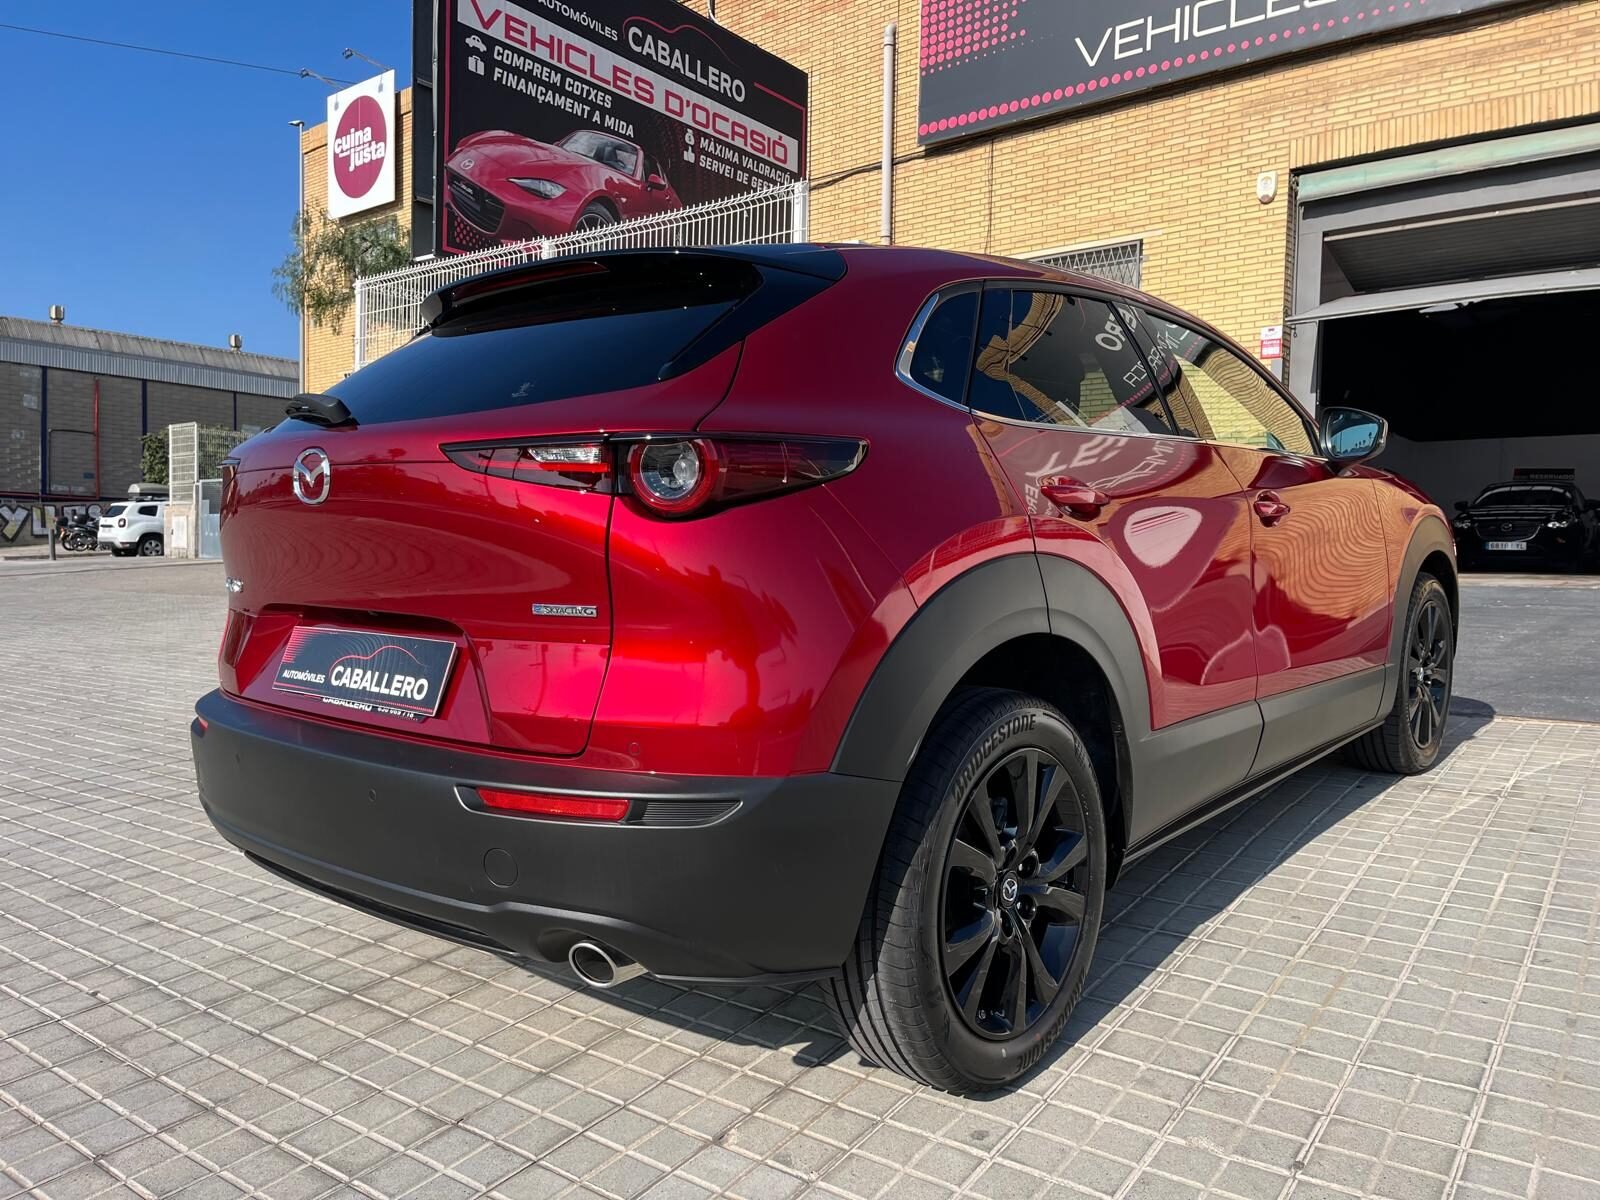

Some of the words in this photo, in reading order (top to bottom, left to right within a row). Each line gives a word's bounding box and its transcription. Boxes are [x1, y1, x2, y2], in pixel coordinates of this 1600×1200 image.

[628, 26, 746, 102] CABALLERO
[1074, 0, 1336, 67] VEHICLE
[469, 0, 654, 104] VEHICLES
[665, 88, 788, 165] D'OCASIÓ
[493, 45, 562, 87] COMPREM
[564, 77, 612, 109] COTXES
[493, 67, 591, 119] FINANÇAMENT
[592, 110, 601, 124] A
[604, 114, 634, 138] MIDA
[335, 126, 372, 154] cuina
[348, 141, 385, 172] justa
[699, 155, 734, 179] SERVEI
[736, 170, 749, 185] DE
[700, 137, 739, 164] MÀXIMA
[742, 155, 791, 185] VALORACIÓ
[282, 669, 326, 684] AUTOMÓVILES
[331, 665, 429, 701] CABALLERO
[953, 714, 1037, 807] BRIDGESTONE
